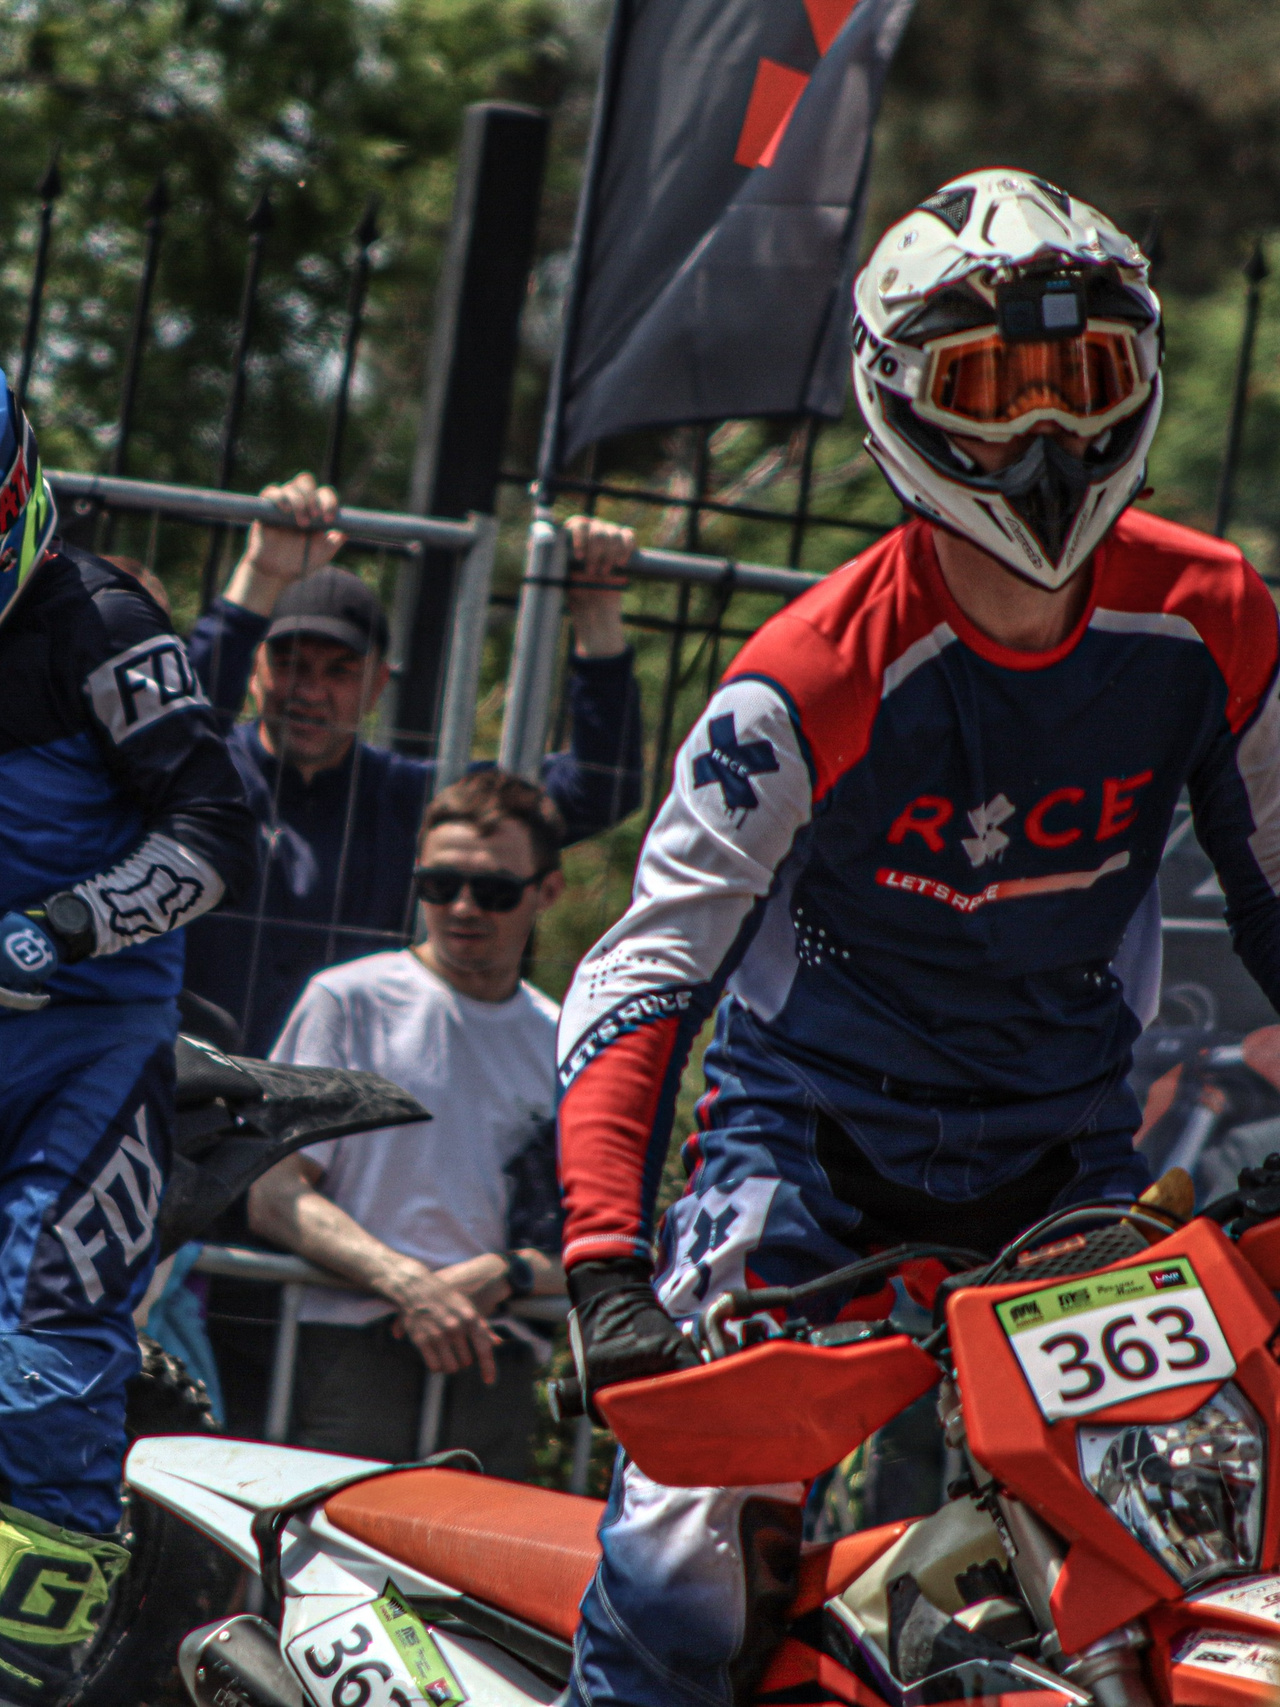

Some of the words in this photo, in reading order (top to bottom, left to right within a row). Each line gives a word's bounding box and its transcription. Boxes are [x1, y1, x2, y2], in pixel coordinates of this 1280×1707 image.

[114, 643, 196, 726] FO
[885, 872, 951, 900] LET'S
[951, 884, 999, 912] RAE
[53, 1104, 163, 1304] FOX
[1040, 1306, 1210, 1403] 363
[304, 1623, 411, 1707] 36
